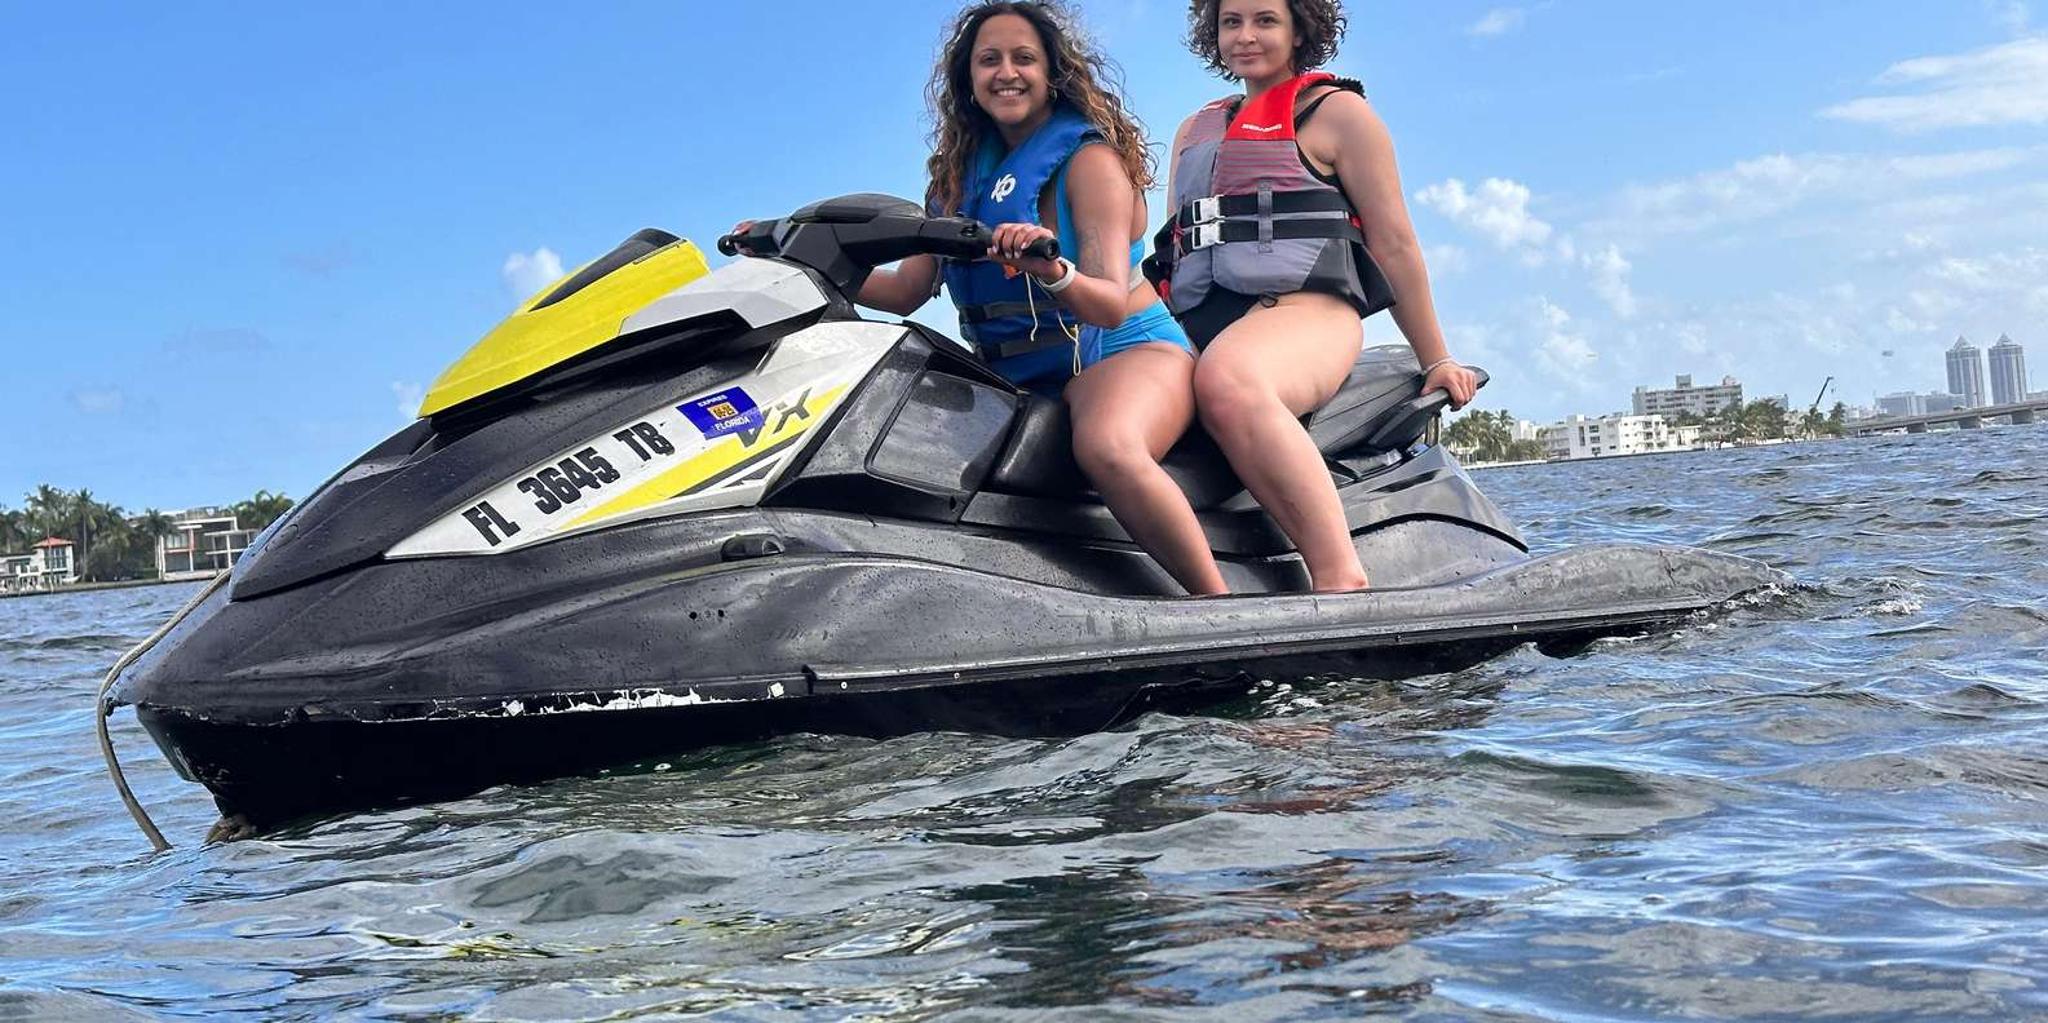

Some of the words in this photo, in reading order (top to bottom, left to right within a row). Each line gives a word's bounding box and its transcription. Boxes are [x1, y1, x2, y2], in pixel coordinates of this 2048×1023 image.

[697, 394, 728, 407] EXPIRES
[715, 416, 751, 431] FLORIDA
[461, 500, 521, 547] FL
[517, 446, 621, 515] 3645
[612, 421, 675, 462] TB
